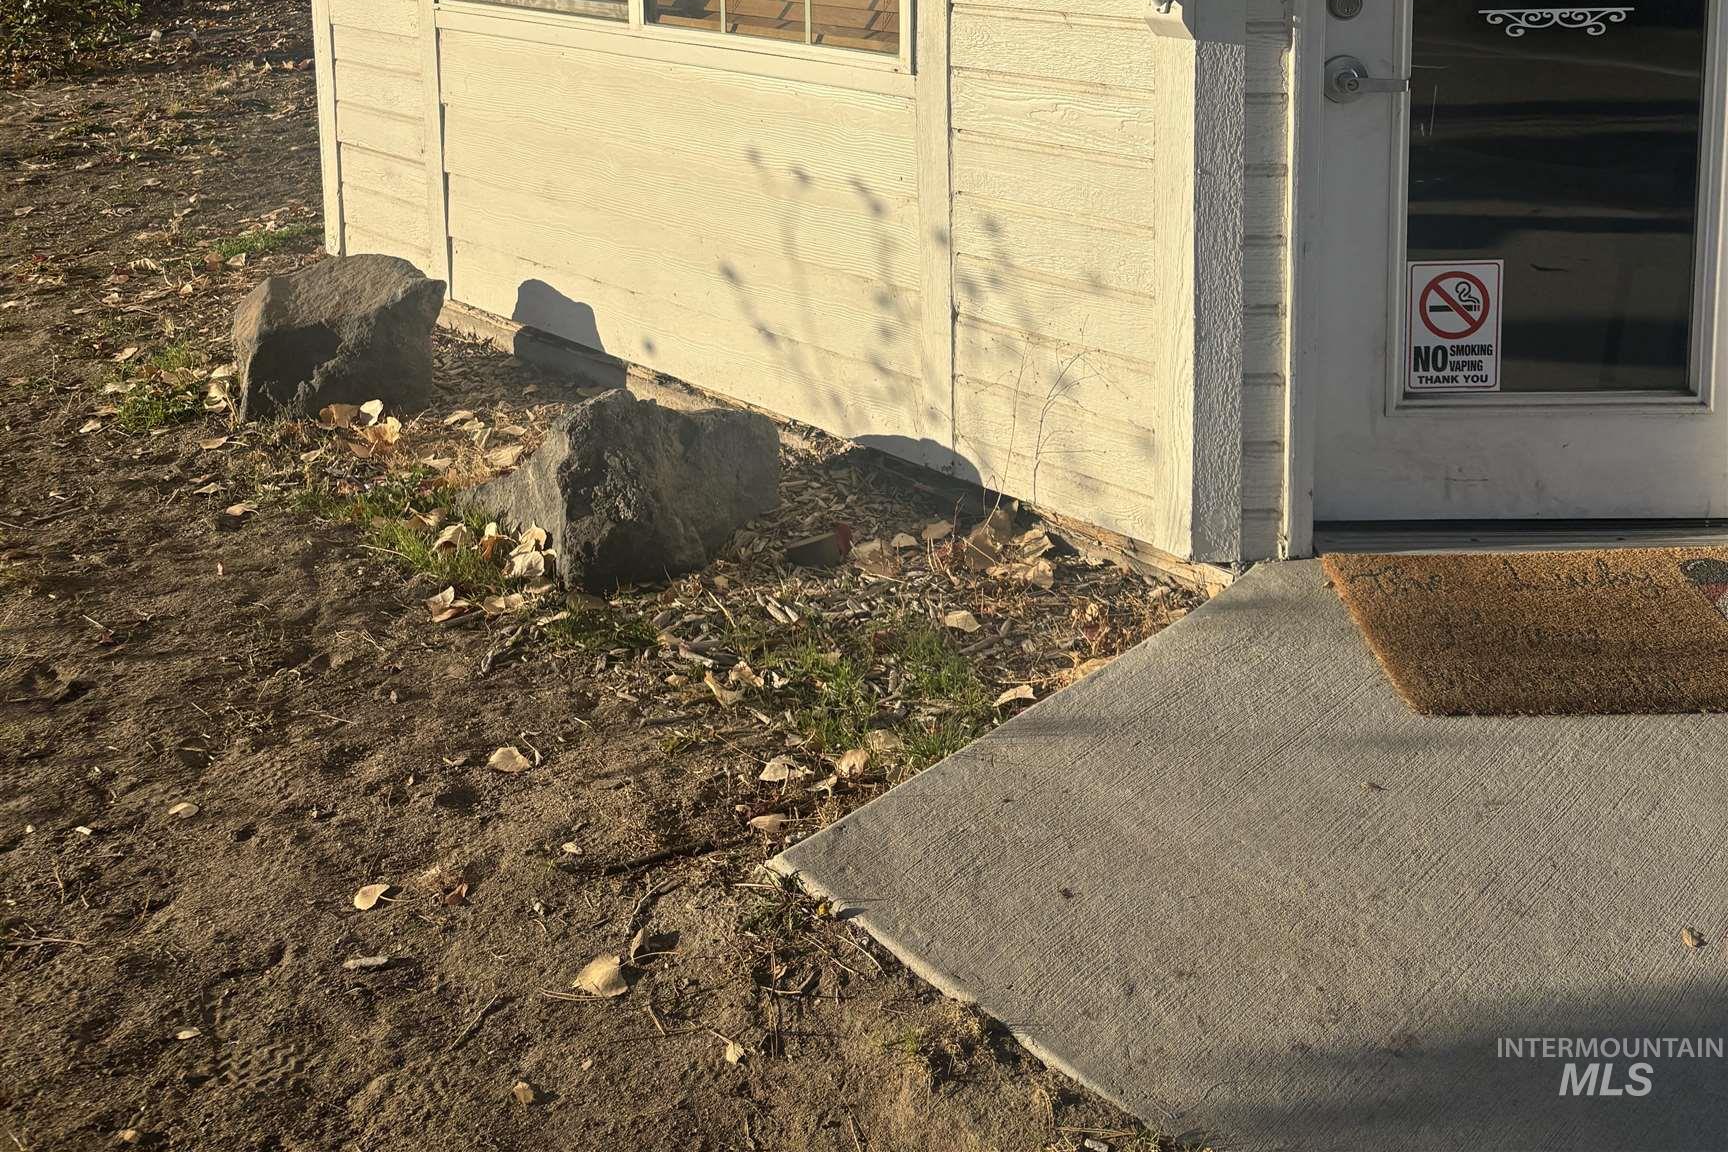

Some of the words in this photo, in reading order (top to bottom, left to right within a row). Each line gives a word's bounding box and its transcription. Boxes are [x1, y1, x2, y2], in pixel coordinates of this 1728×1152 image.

[1413, 345, 1449, 373] NO
[1450, 344, 1493, 356] SMOKING
[1449, 359, 1483, 372] VAPING
[1417, 375, 1459, 384] THANK
[1463, 374, 1489, 384] YOU
